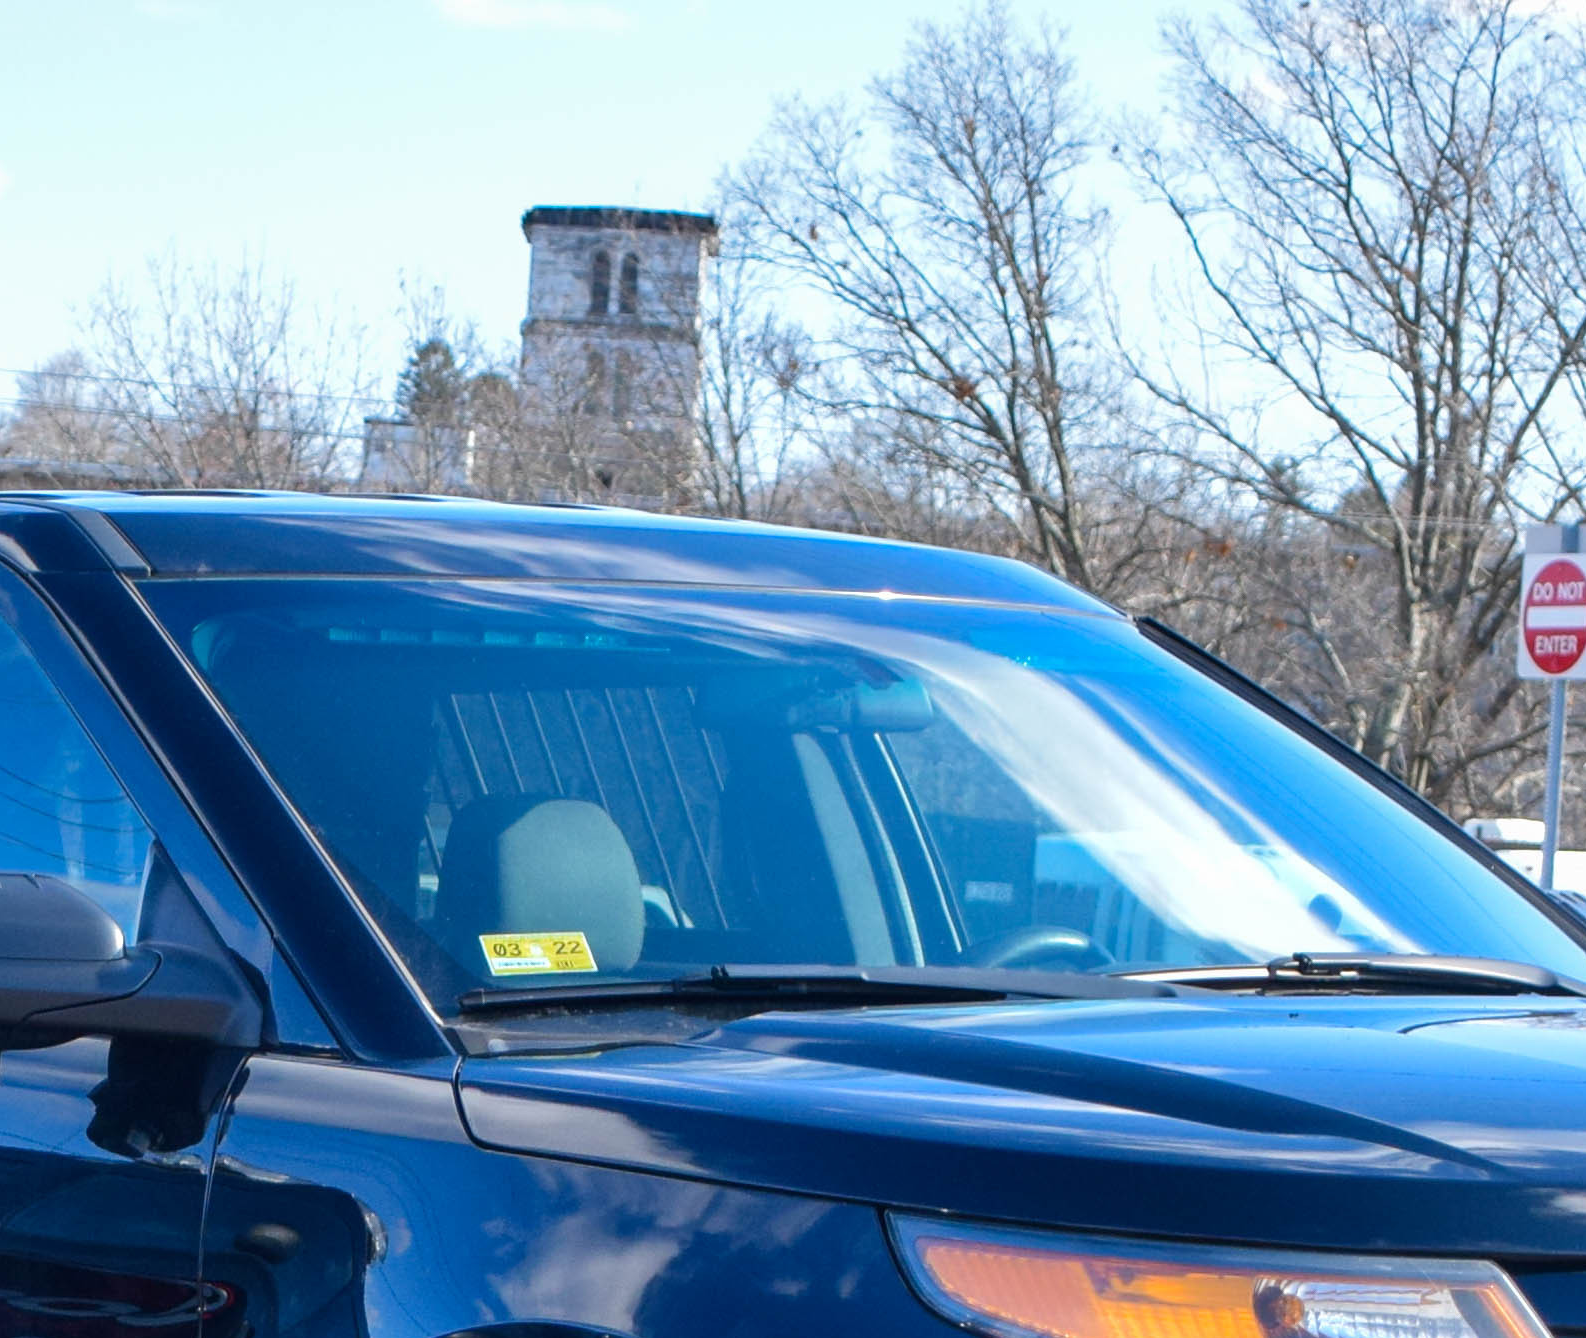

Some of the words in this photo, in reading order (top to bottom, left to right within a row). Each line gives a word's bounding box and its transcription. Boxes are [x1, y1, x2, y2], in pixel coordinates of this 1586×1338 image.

[1532, 581, 1553, 601] DO
[1557, 580, 1585, 601] NOT
[1535, 634, 1578, 656] ENTER
[493, 943, 522, 957] 03
[553, 941, 583, 955] 22
